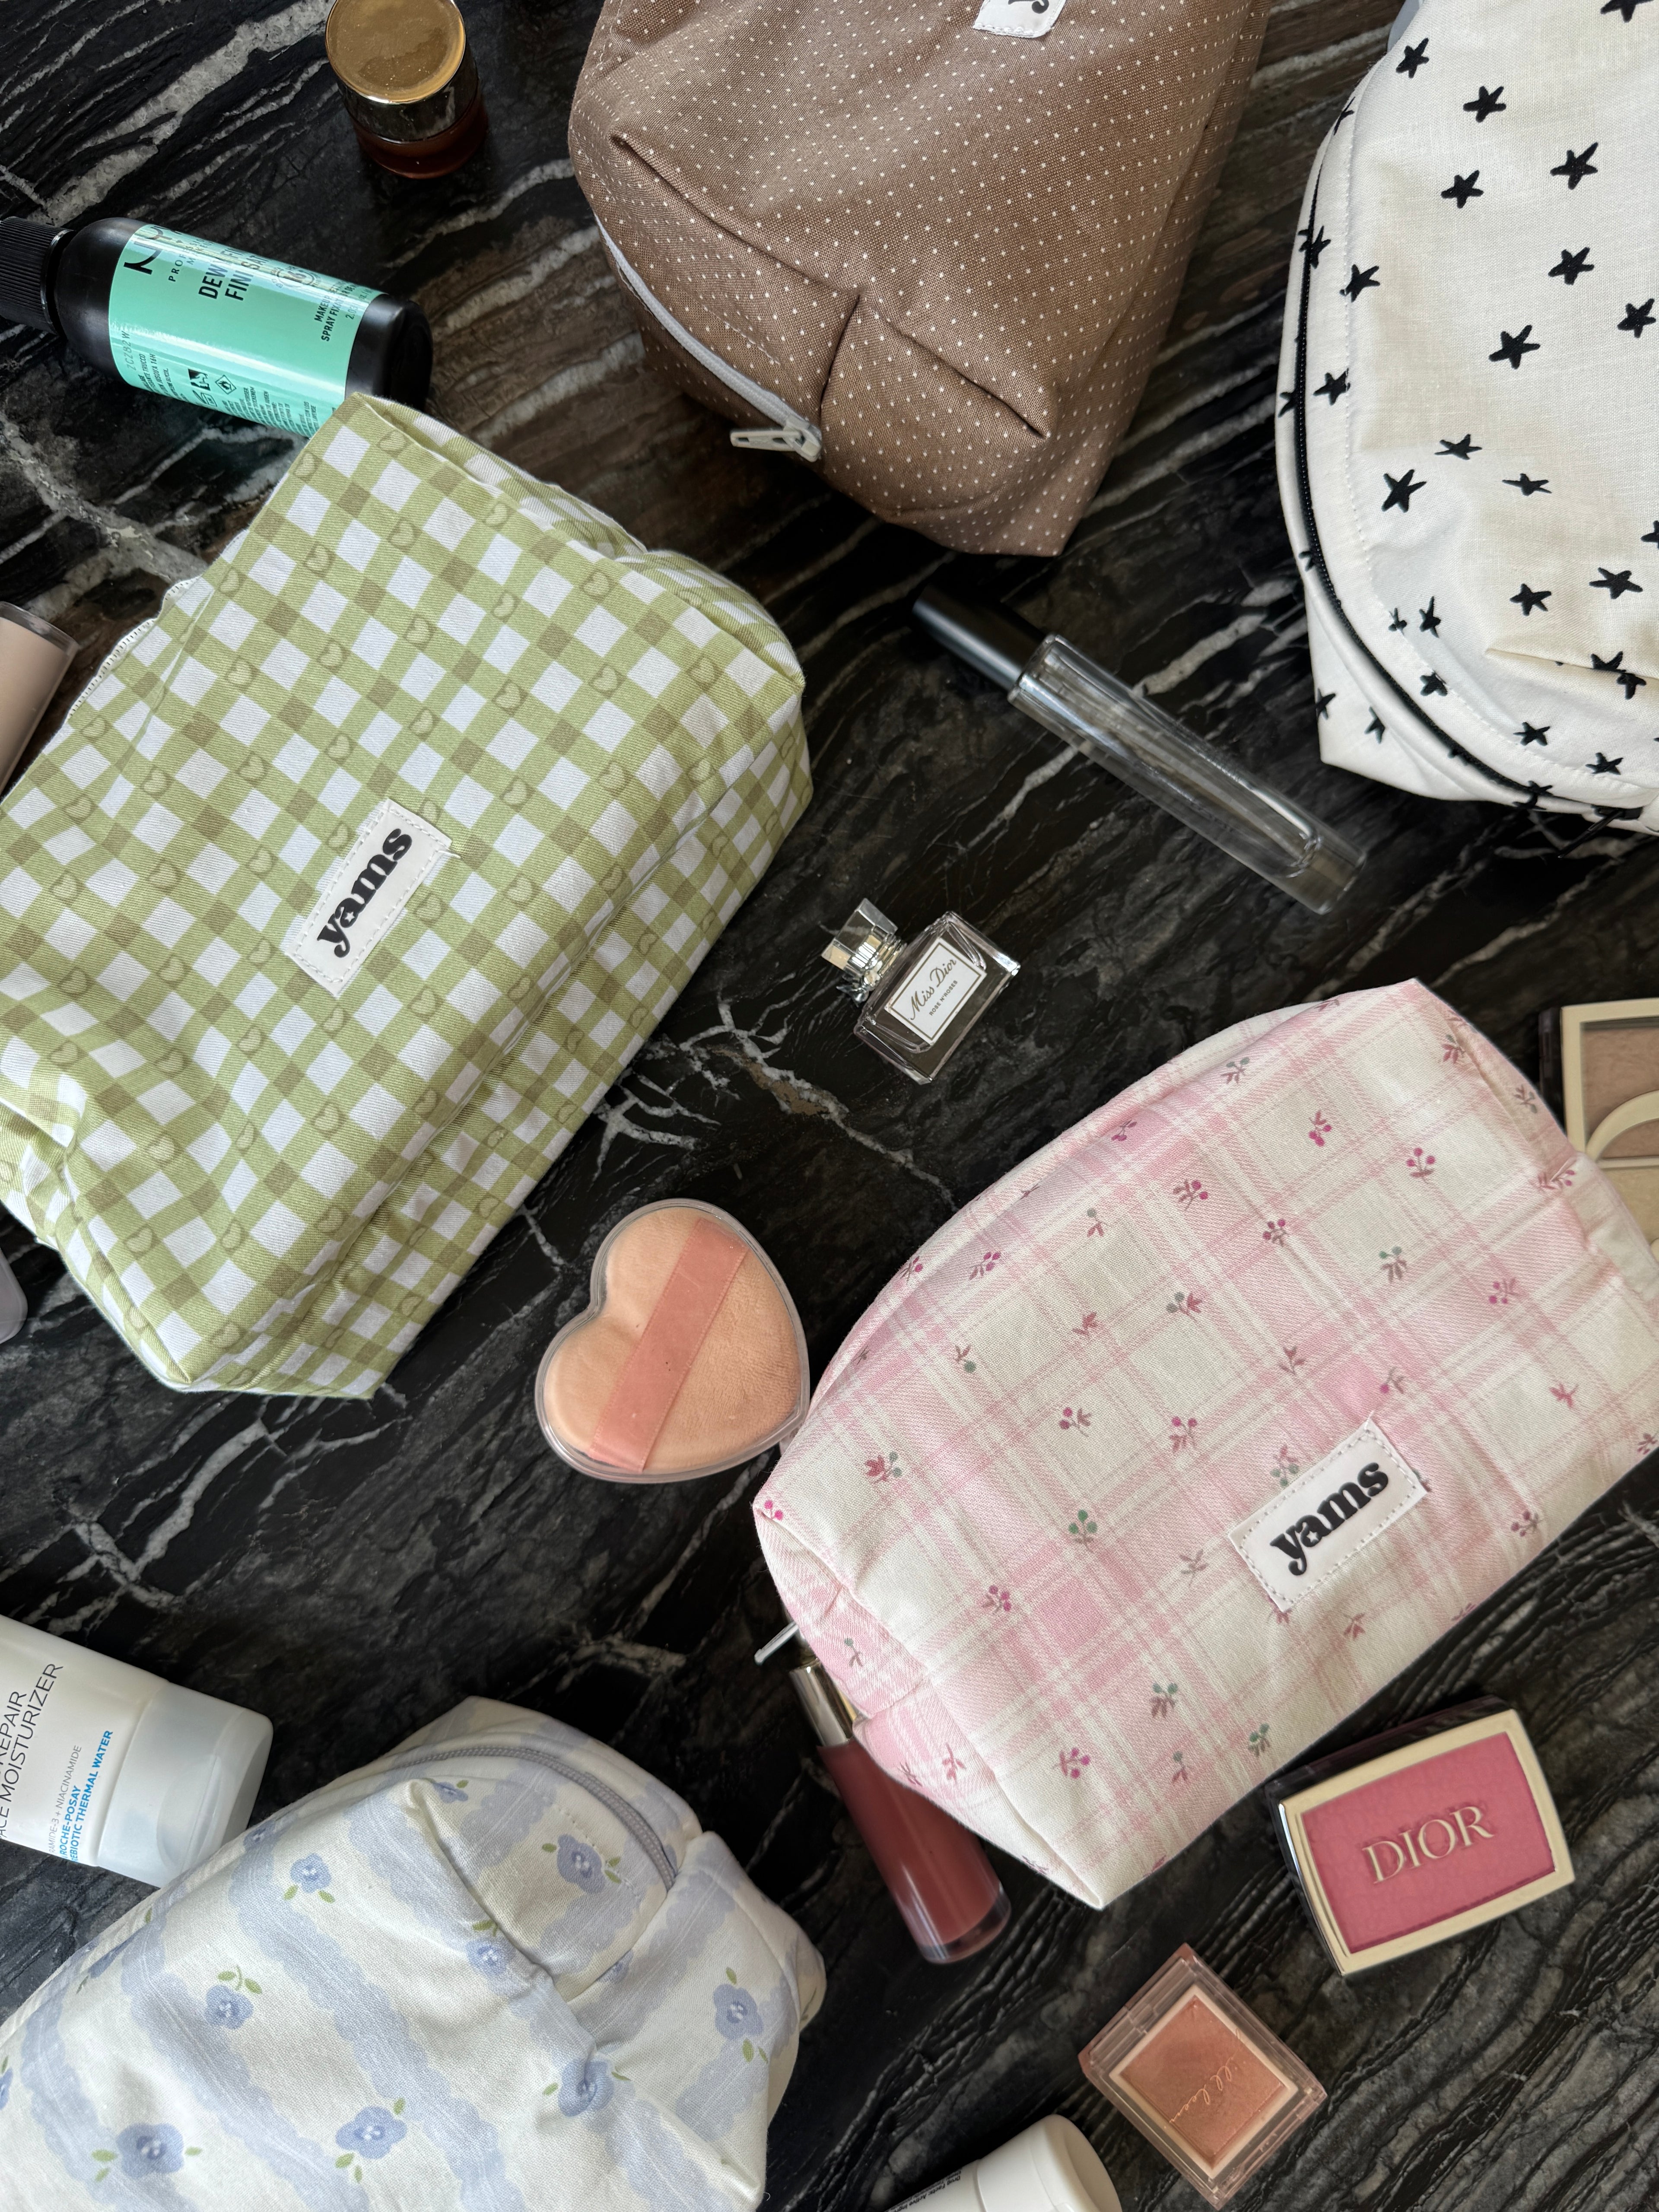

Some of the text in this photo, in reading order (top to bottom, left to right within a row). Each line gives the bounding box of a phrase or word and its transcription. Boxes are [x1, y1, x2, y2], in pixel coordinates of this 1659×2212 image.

[225, 270, 254, 301] FINI
[314, 296, 332, 322] MAKEUP
[321, 316, 335, 341] SPRAY
[317, 828, 412, 958] yams
[910, 960, 956, 1020] Miss Dior
[929, 980, 957, 1016] ROSE N'ROSES
[1270, 1462, 1388, 1576] yams
[0, 1664, 64, 1802] MOISTURIZER
[55, 1745, 82, 1808] NIACINAMIDE
[76, 1771, 99, 1821] THERMAL
[92, 1730, 113, 1768] WATER
[60, 1786, 81, 1856] ROCHE-POSAY
[1361, 1806, 1494, 1885] DIOR
[947, 2175, 961, 2185] Drug
